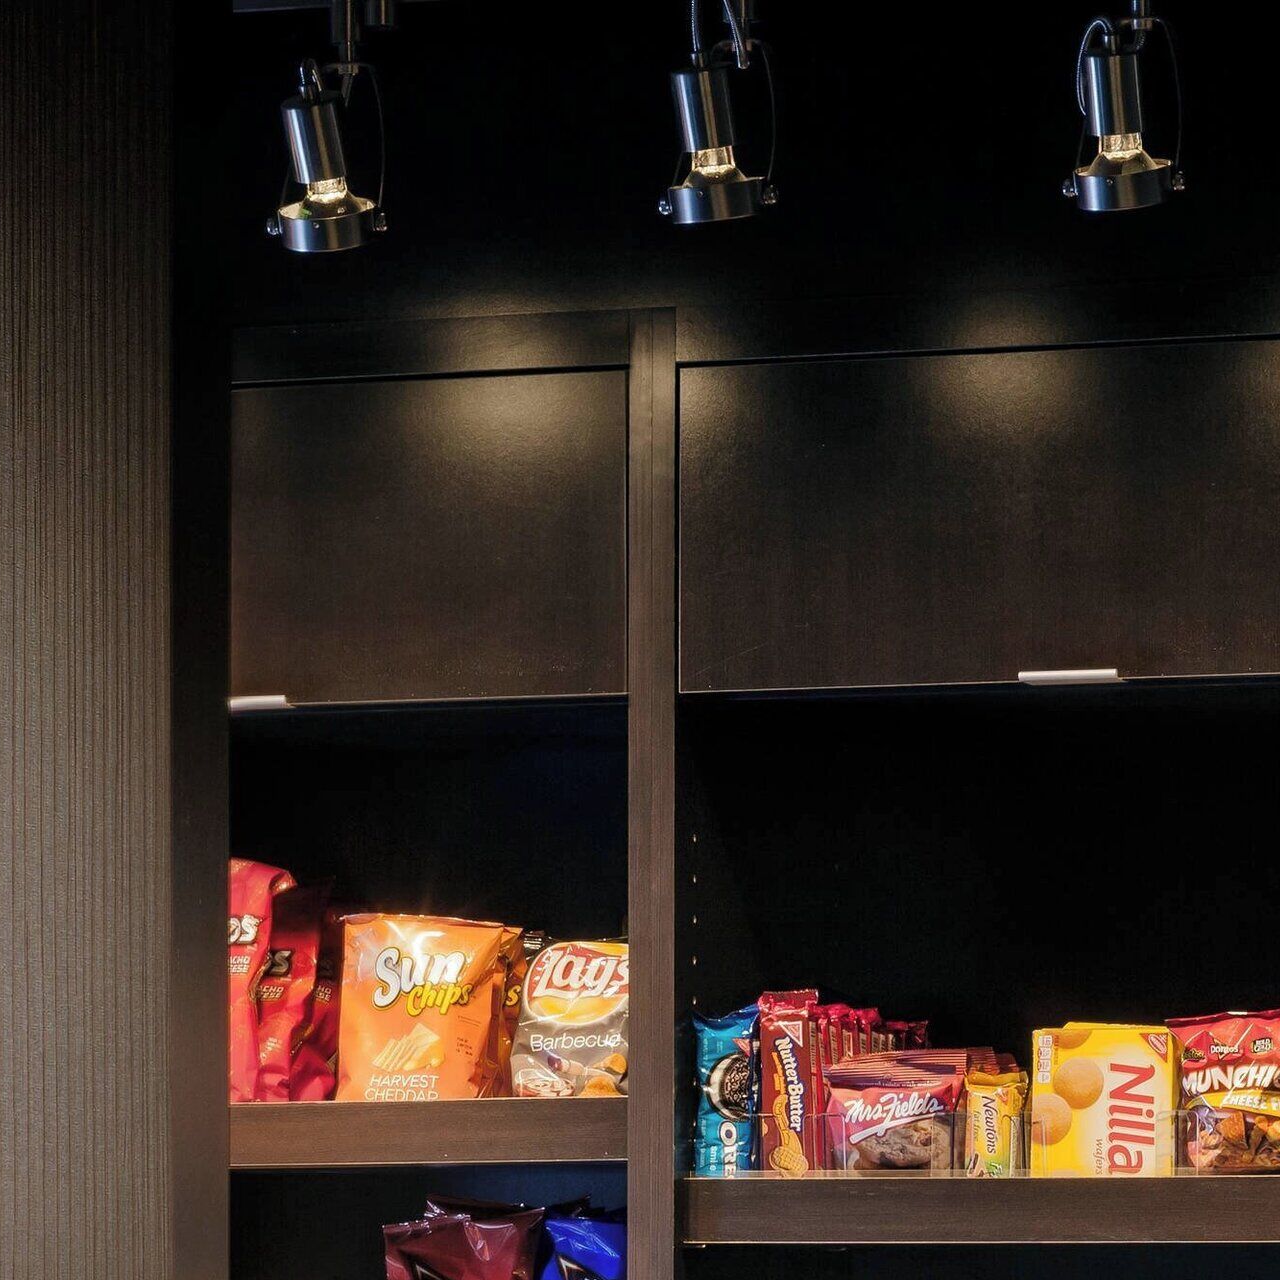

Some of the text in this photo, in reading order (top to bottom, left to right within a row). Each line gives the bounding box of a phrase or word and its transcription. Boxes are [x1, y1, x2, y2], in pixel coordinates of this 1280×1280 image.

[373, 947, 466, 1008] Sun
[406, 983, 473, 1017] Chips
[530, 1032, 621, 1052] Barbecue
[369, 1074, 440, 1089] HARVEST
[774, 1036, 804, 1132] Nutter Butter
[880, 1091, 944, 1129] Fields
[981, 1095, 1000, 1155] Newtons
[1107, 1062, 1157, 1176] Nilla
[719, 1120, 738, 1178] ORE
[1093, 1138, 1104, 1175] wafers
